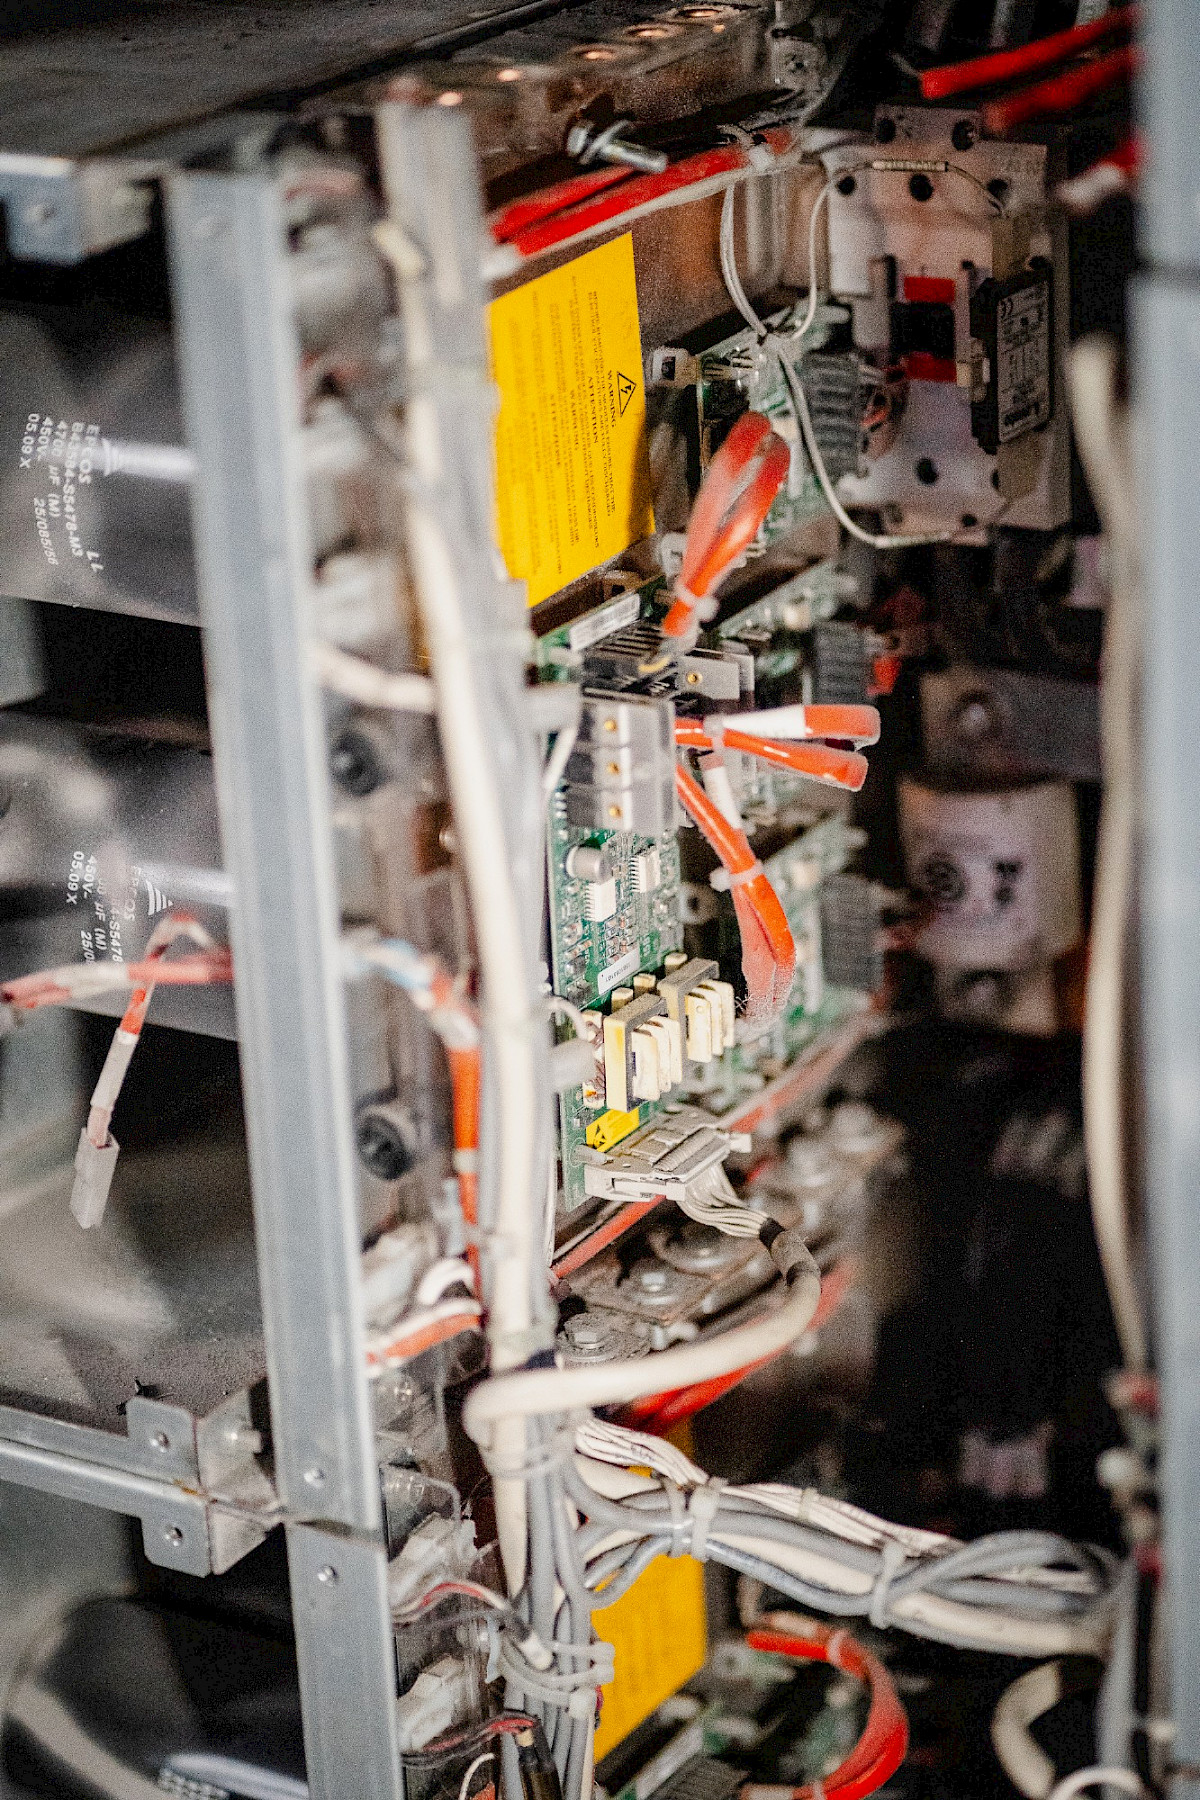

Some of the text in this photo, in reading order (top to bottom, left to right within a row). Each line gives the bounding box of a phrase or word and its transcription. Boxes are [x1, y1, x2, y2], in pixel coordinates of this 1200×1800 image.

[587, 374, 598, 444] ATTENTION
[607, 369, 616, 429] WARNING
[19, 413, 40, 468] 05.09 X
[52, 421, 67, 457] 4700
[78, 424, 100, 485] EPCOS
[33, 498, 58, 565] 25/085/56
[48, 493, 61, 517] (M)
[66, 851, 84, 905] 05.09 X
[80, 930, 94, 963] 25/0
[95, 928, 106, 950] (M)
